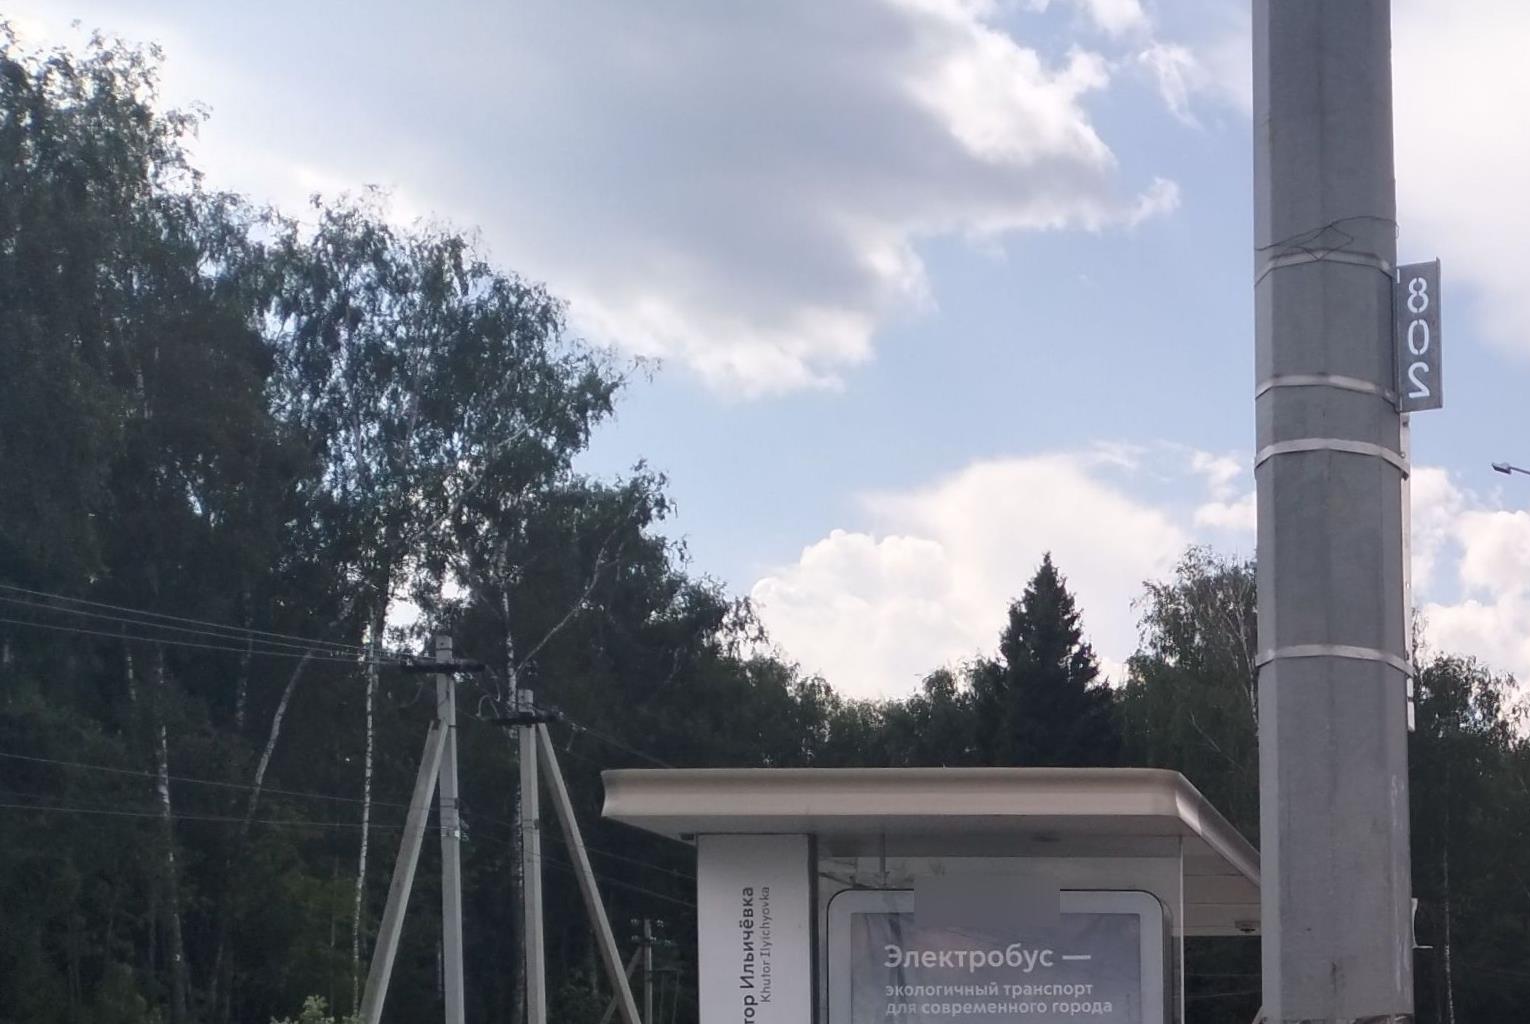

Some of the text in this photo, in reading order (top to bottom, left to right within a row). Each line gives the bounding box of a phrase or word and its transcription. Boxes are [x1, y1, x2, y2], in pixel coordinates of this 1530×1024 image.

[739, 886, 755, 989] Ильичёвка
[759, 886, 773, 1003] Khutor Ilyichyovka
[883, 943, 1054, 973] Электробус
[885, 982, 1093, 999] экологичный транспорт
[885, 1000, 1113, 1017] для современного города
